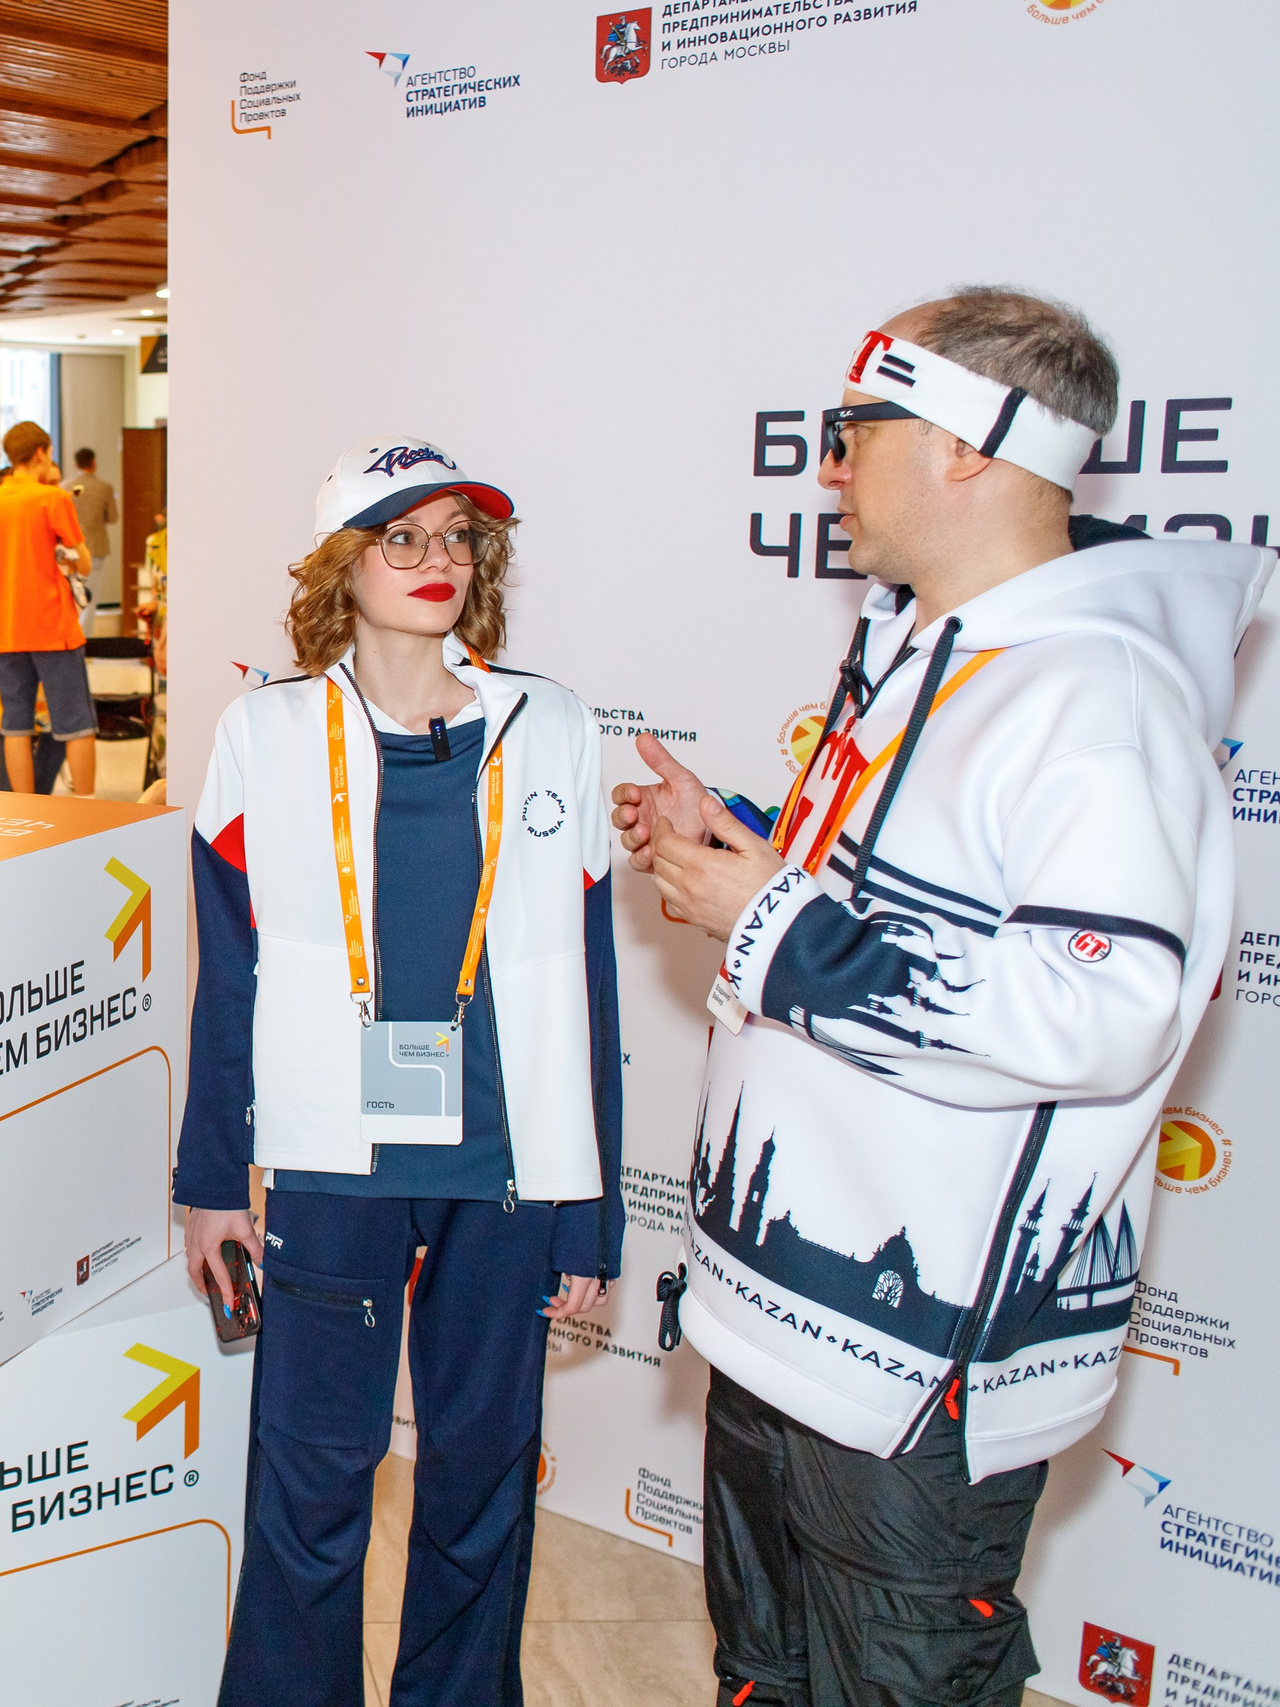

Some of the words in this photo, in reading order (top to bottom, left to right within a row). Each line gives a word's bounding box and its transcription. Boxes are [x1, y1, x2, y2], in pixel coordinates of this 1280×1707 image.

[662, 40, 671, 51] И
[676, 15, 827, 49] ИННОВАЦИОННОГО
[834, 0, 917, 24] РАЗВИТИЯ
[661, 50, 718, 69] ГОРОДА
[724, 39, 790, 60] МОСКВЫ
[239, 71, 267, 83] Фонд
[239, 80, 297, 99] Поддержки
[406, 66, 476, 88] АГЕНТСТВО
[406, 74, 521, 104] СТРАТЕГИЧЕСКИХ
[239, 91, 302, 110] Социальных
[239, 107, 287, 124] Проектов
[406, 96, 487, 119] ИНИЦИАТИВ
[522, 791, 538, 822] PUTIN
[545, 790, 566, 814] TEAM
[527, 820, 564, 838] RUSSIA
[736, 867, 807, 956] KAZAN
[36, 986, 138, 1060] БИЗНЕС
[366, 1101, 395, 1109] ГОСТЬ
[734, 1280, 822, 1339] KAZAN
[982, 1358, 1057, 1394] KAZAN
[1127, 1326, 1210, 1359] Проектов
[1129, 1310, 1237, 1350] Социальных
[596, 1340, 661, 1367] РАЗВИТИЯ
[638, 1466, 671, 1488] Фонд
[11, 1462, 175, 1534] БИЗНЕС
[636, 1505, 693, 1535] Проектов
[1163, 1503, 1275, 1549] АГЕНТСТВО
